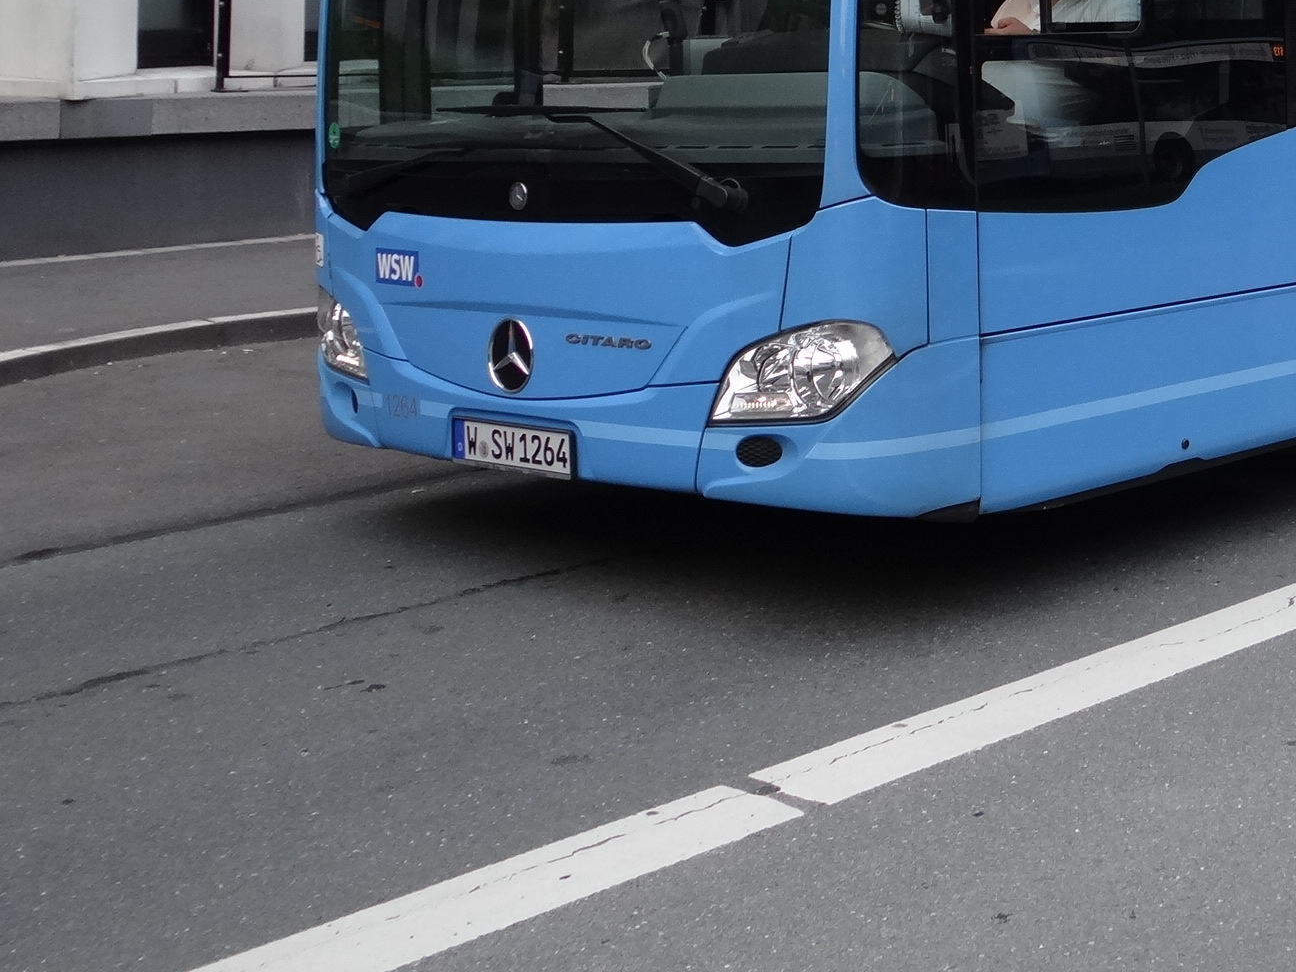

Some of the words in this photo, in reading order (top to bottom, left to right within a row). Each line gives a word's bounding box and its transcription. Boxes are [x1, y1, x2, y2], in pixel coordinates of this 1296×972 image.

[377, 253, 414, 281] WSW
[565, 333, 652, 350] CITARO
[467, 425, 478, 456] W
